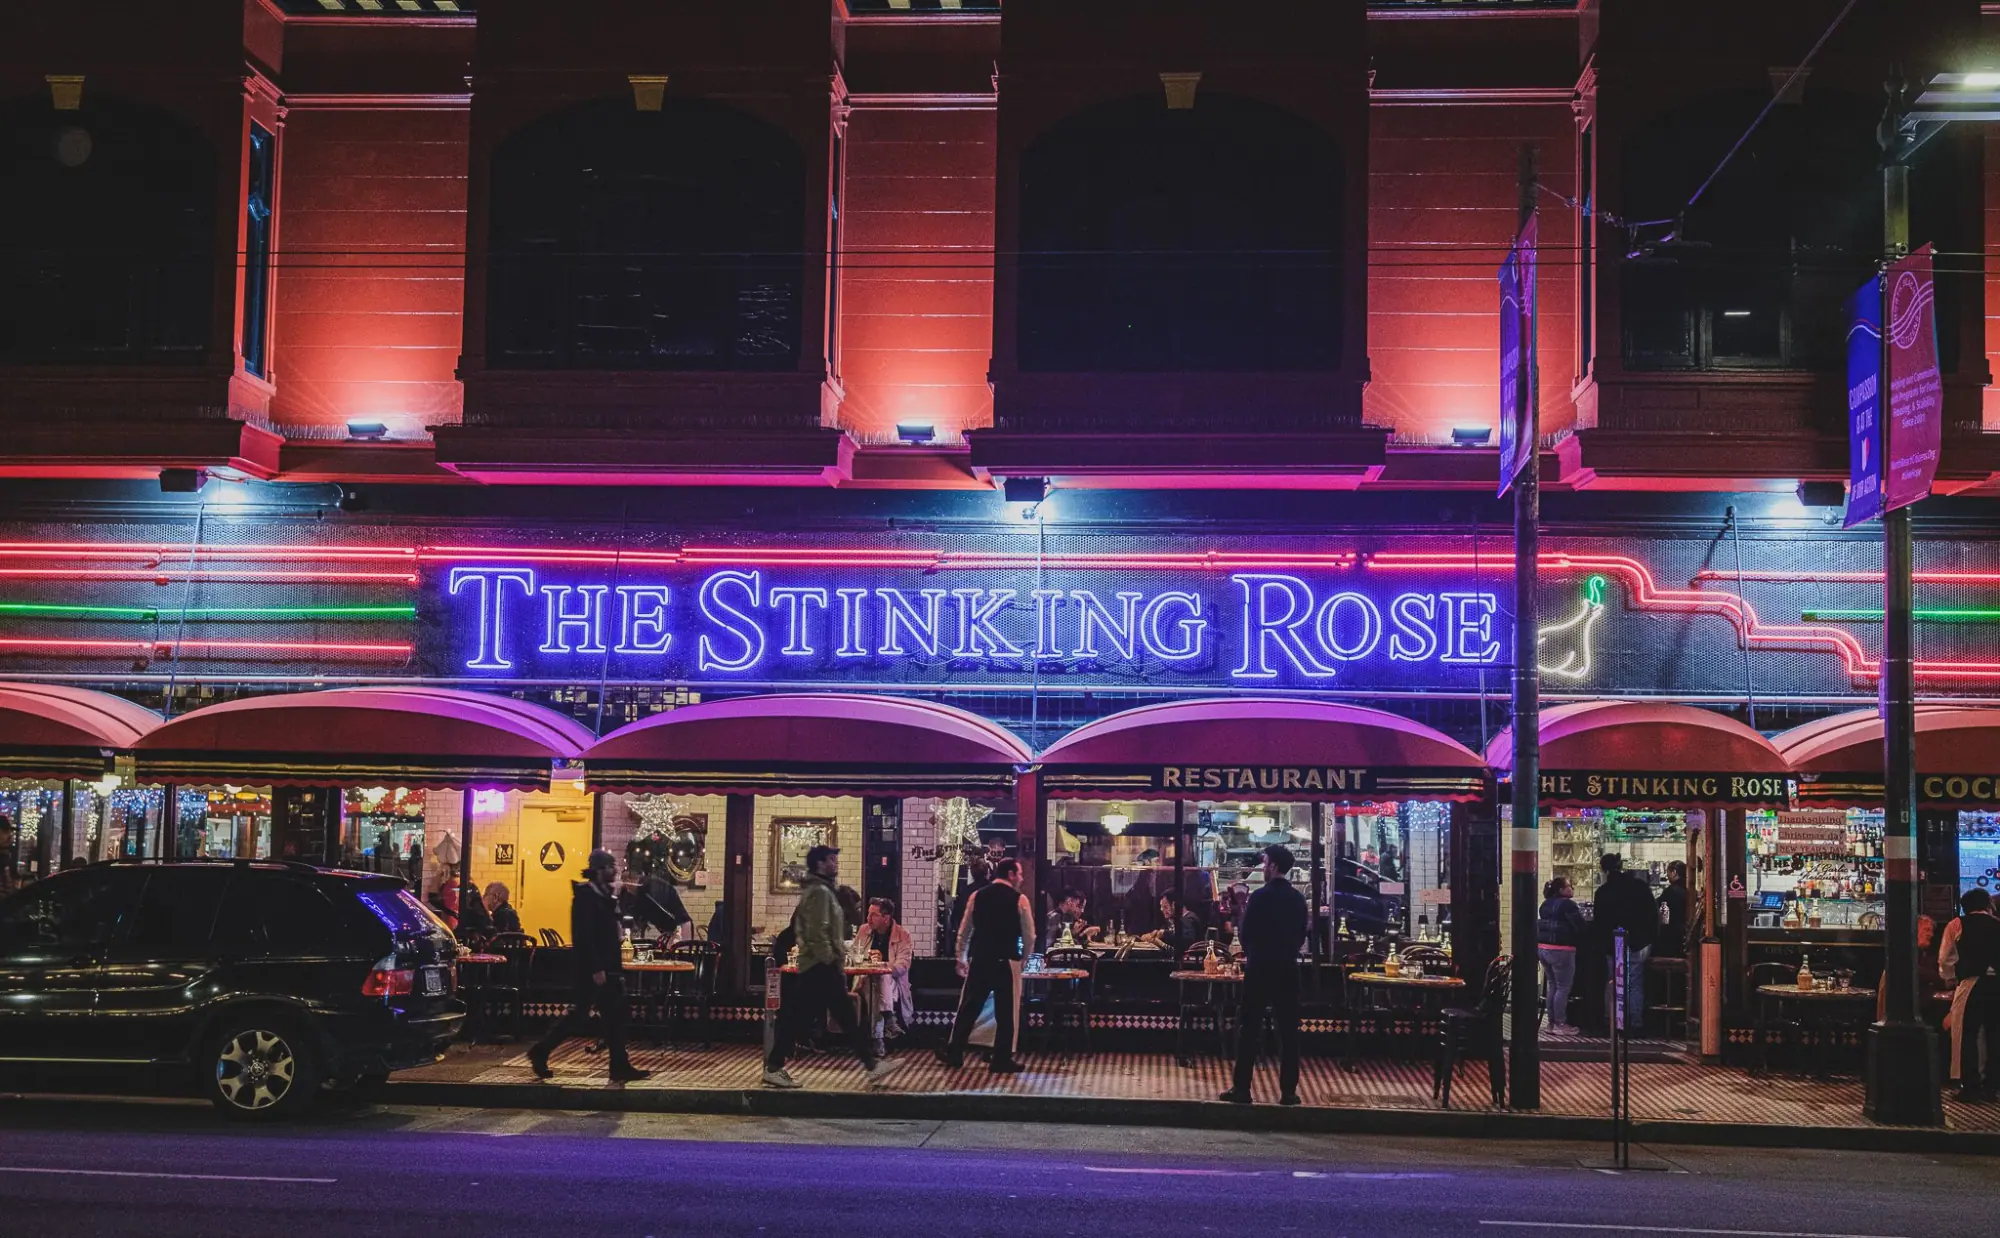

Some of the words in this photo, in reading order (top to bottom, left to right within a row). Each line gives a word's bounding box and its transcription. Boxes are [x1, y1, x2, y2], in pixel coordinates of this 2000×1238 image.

[449, 567, 672, 669] THE
[699, 570, 1206, 675] STINKING
[1231, 574, 1500, 678] ROSE
[1163, 767, 1366, 790] RESTAURANT
[1538, 775, 1572, 794] HE
[1587, 775, 1718, 796] STINKING
[1731, 777, 1782, 797] ROSE
[1778, 831, 1825, 840] Christmas
[1850, 855, 1884, 875] ROS
